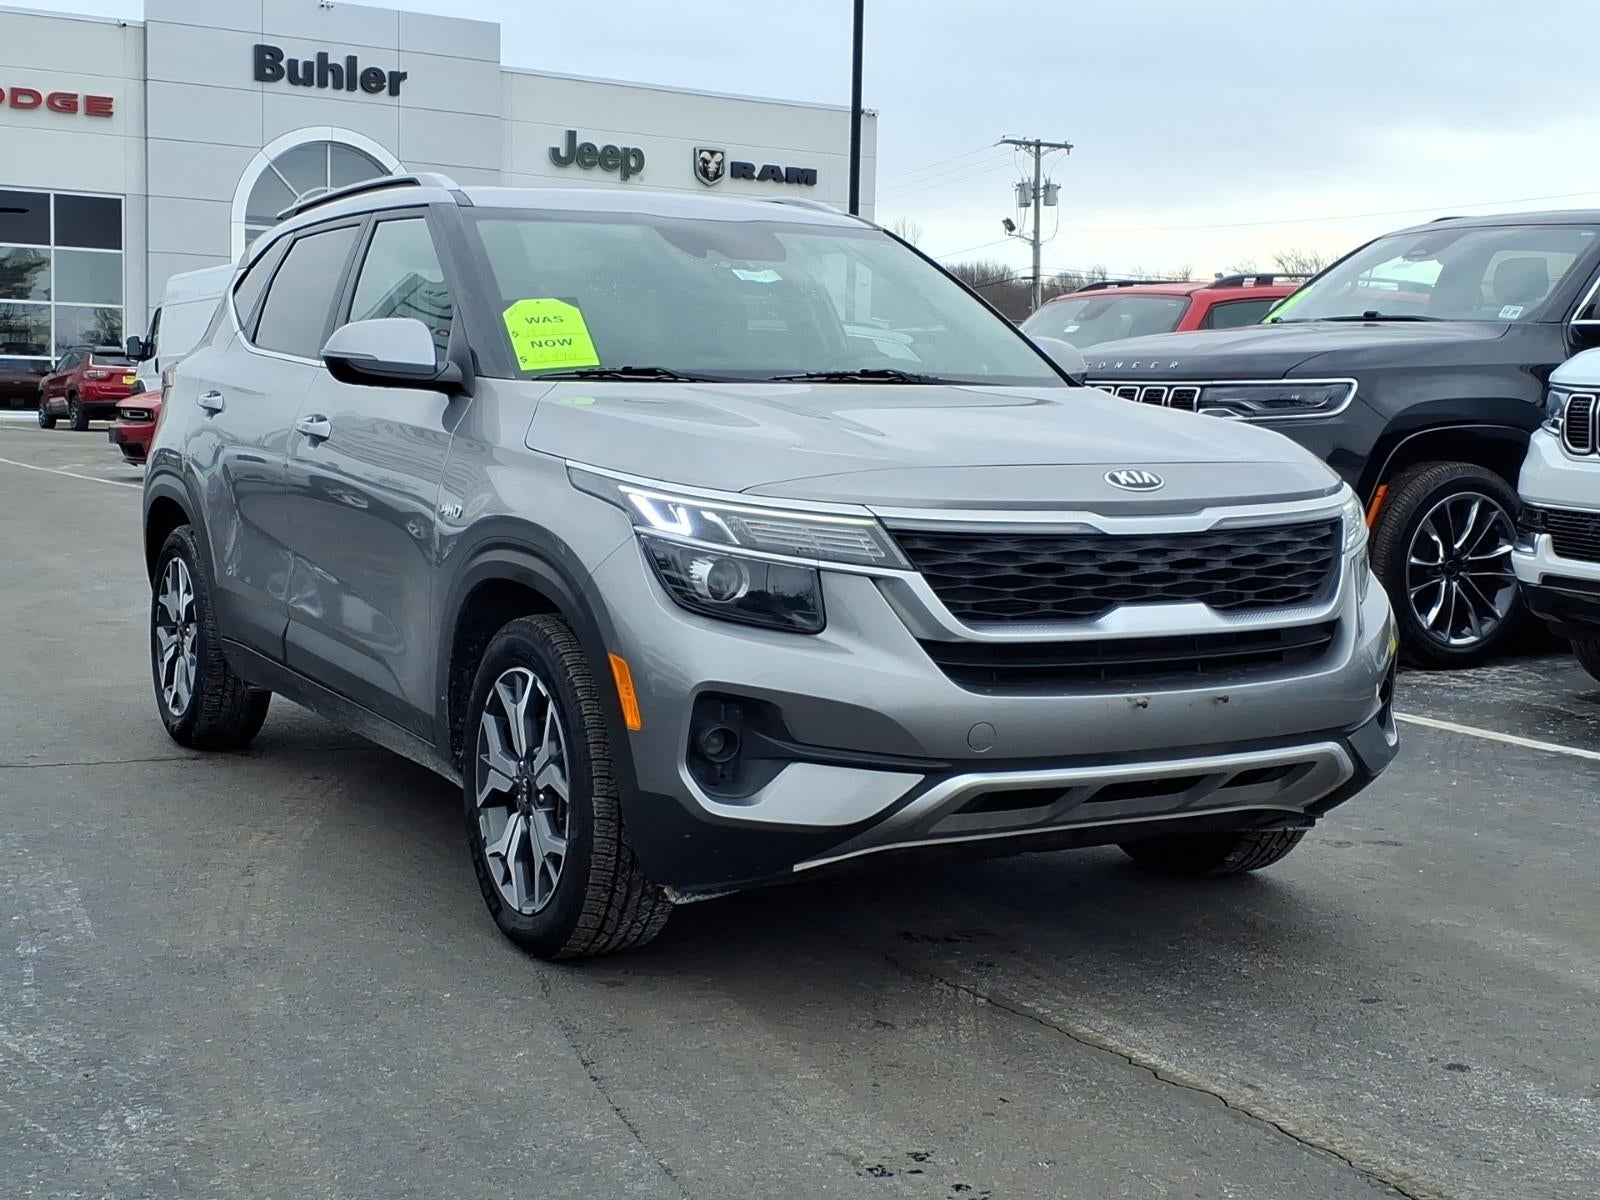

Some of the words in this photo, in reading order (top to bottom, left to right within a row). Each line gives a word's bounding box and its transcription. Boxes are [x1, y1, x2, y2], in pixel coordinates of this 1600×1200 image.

[254, 43, 408, 97] Buhler
[0, 86, 114, 118] DGE
[549, 130, 645, 181] Jeep
[730, 160, 818, 186] RAM
[525, 315, 565, 325] WAS
[530, 338, 573, 348] NOW
[1112, 470, 1160, 485] KIA
